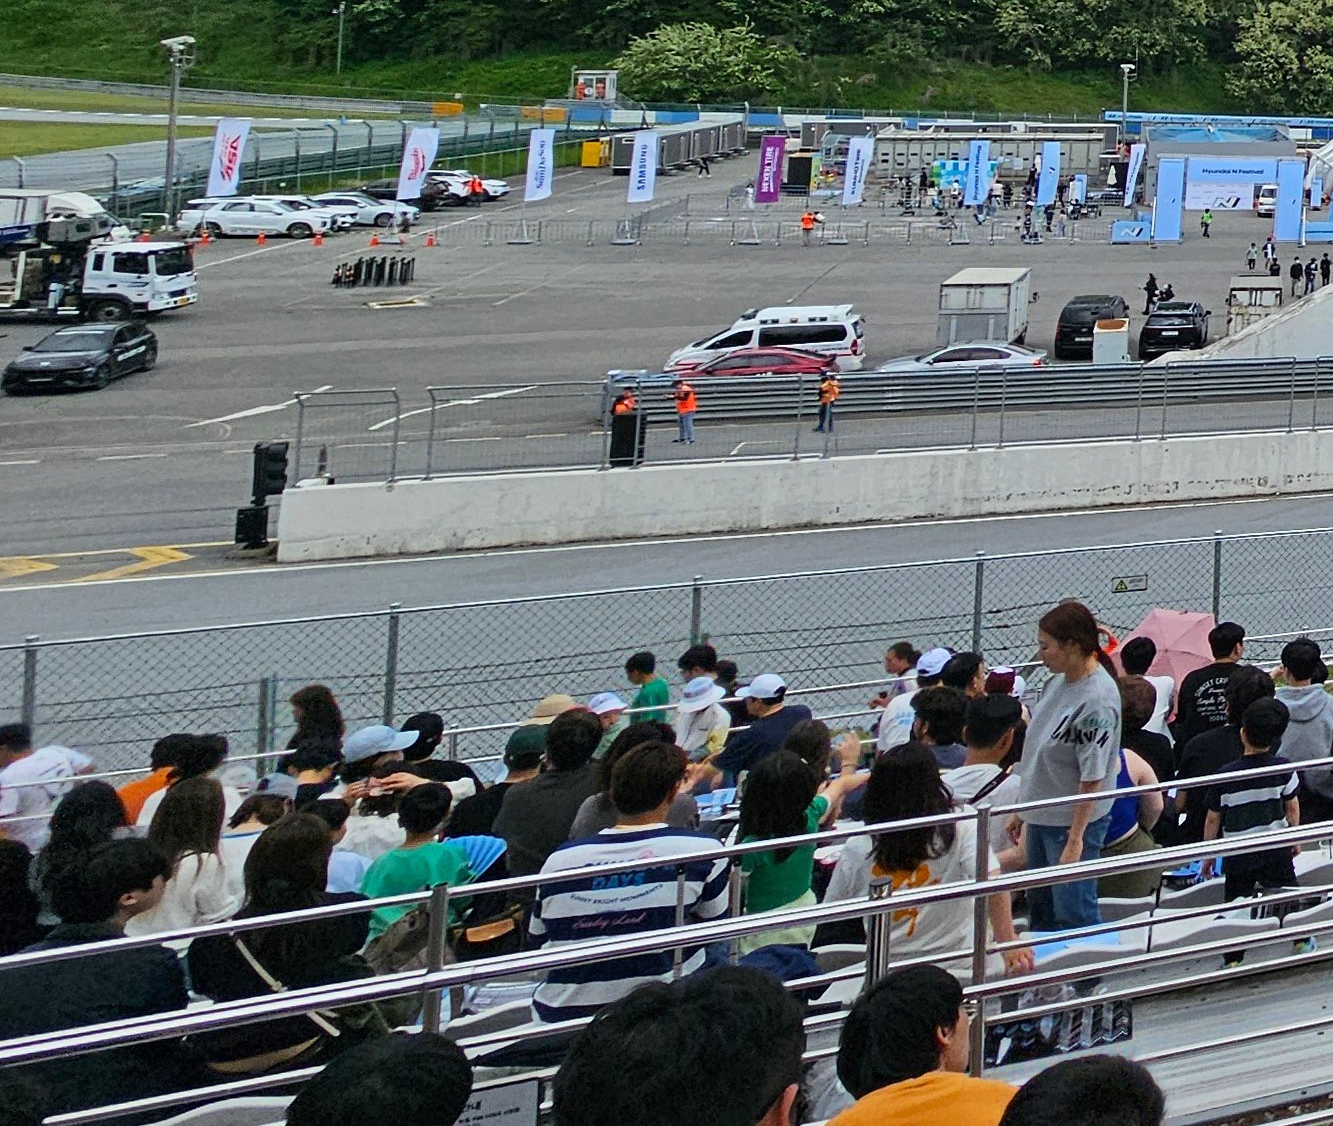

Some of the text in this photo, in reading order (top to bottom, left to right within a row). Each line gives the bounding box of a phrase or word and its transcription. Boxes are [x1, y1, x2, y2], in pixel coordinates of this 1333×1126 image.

[765, 145, 775, 164] TIRE
[636, 143, 648, 191] SAMSUNG
[761, 165, 771, 193] NEXEN
[591, 871, 646, 891] DAYS
